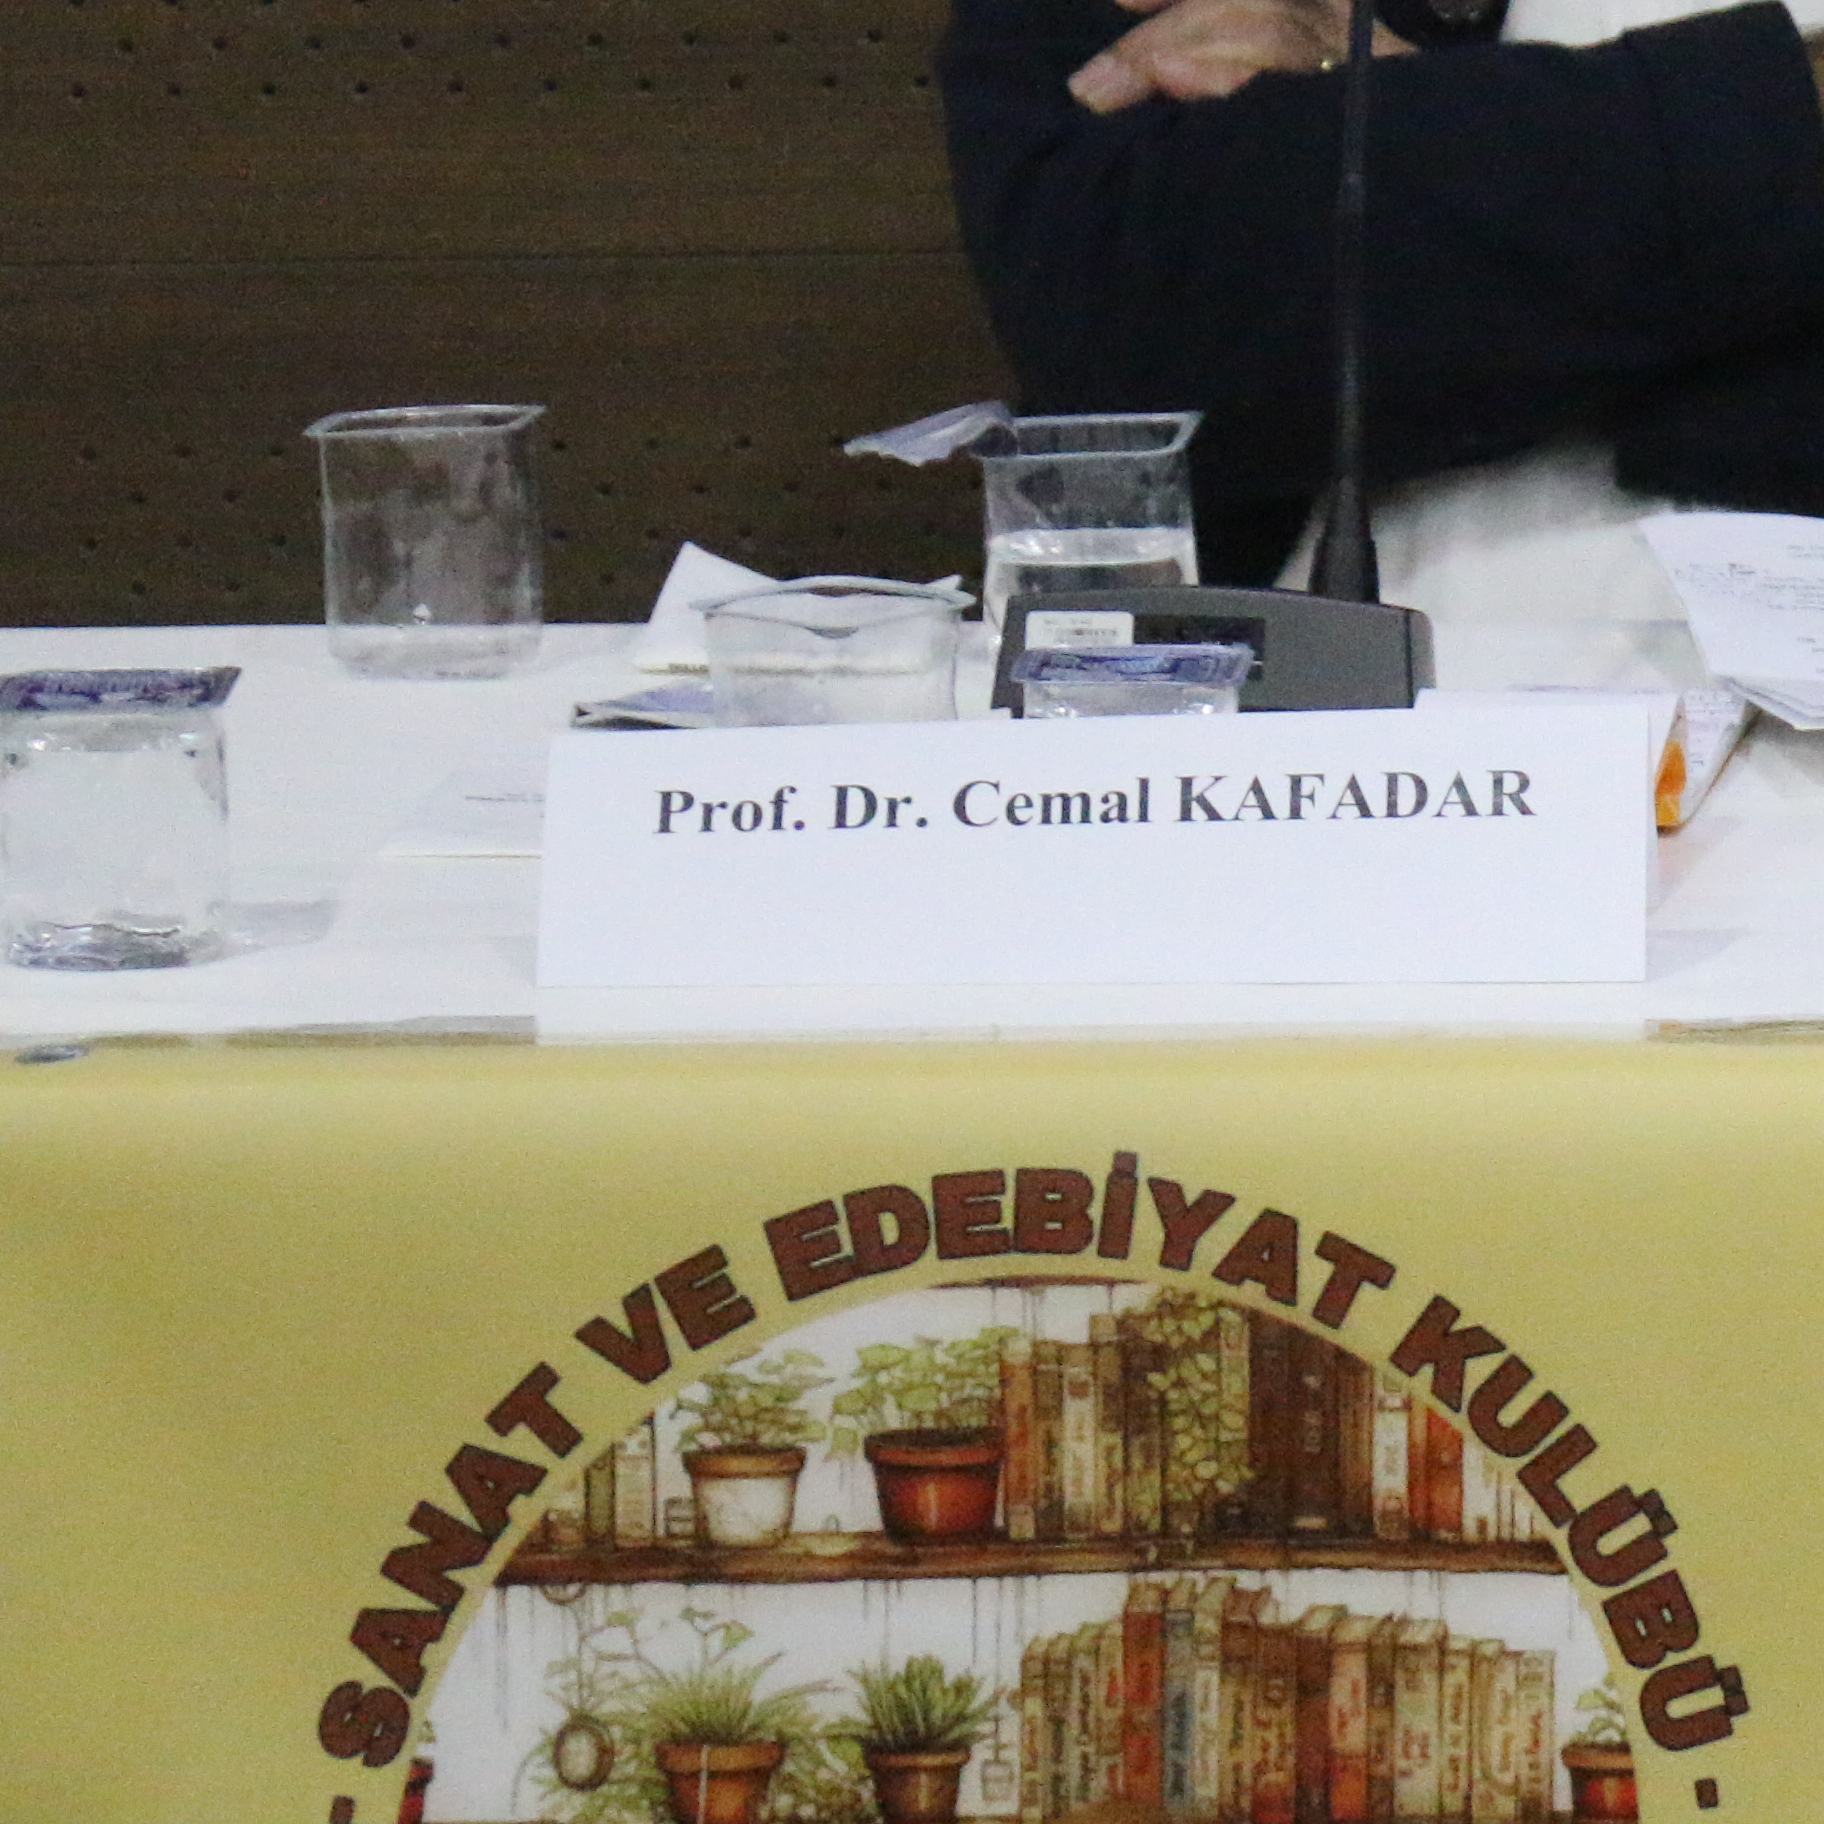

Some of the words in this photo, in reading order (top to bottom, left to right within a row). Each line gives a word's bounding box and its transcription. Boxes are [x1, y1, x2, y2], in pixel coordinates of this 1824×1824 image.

[655, 788, 806, 836] Prof.
[831, 783, 930, 831] Dr.
[952, 777, 1150, 827] Cemal
[1176, 769, 1538, 824] KAFADAR
[318, 1361, 584, 1769] SANAT
[574, 1244, 757, 1386] VE
[763, 1151, 1397, 1331] EDEBİYAT
[1389, 1294, 1751, 1753] KULÜBÜ
